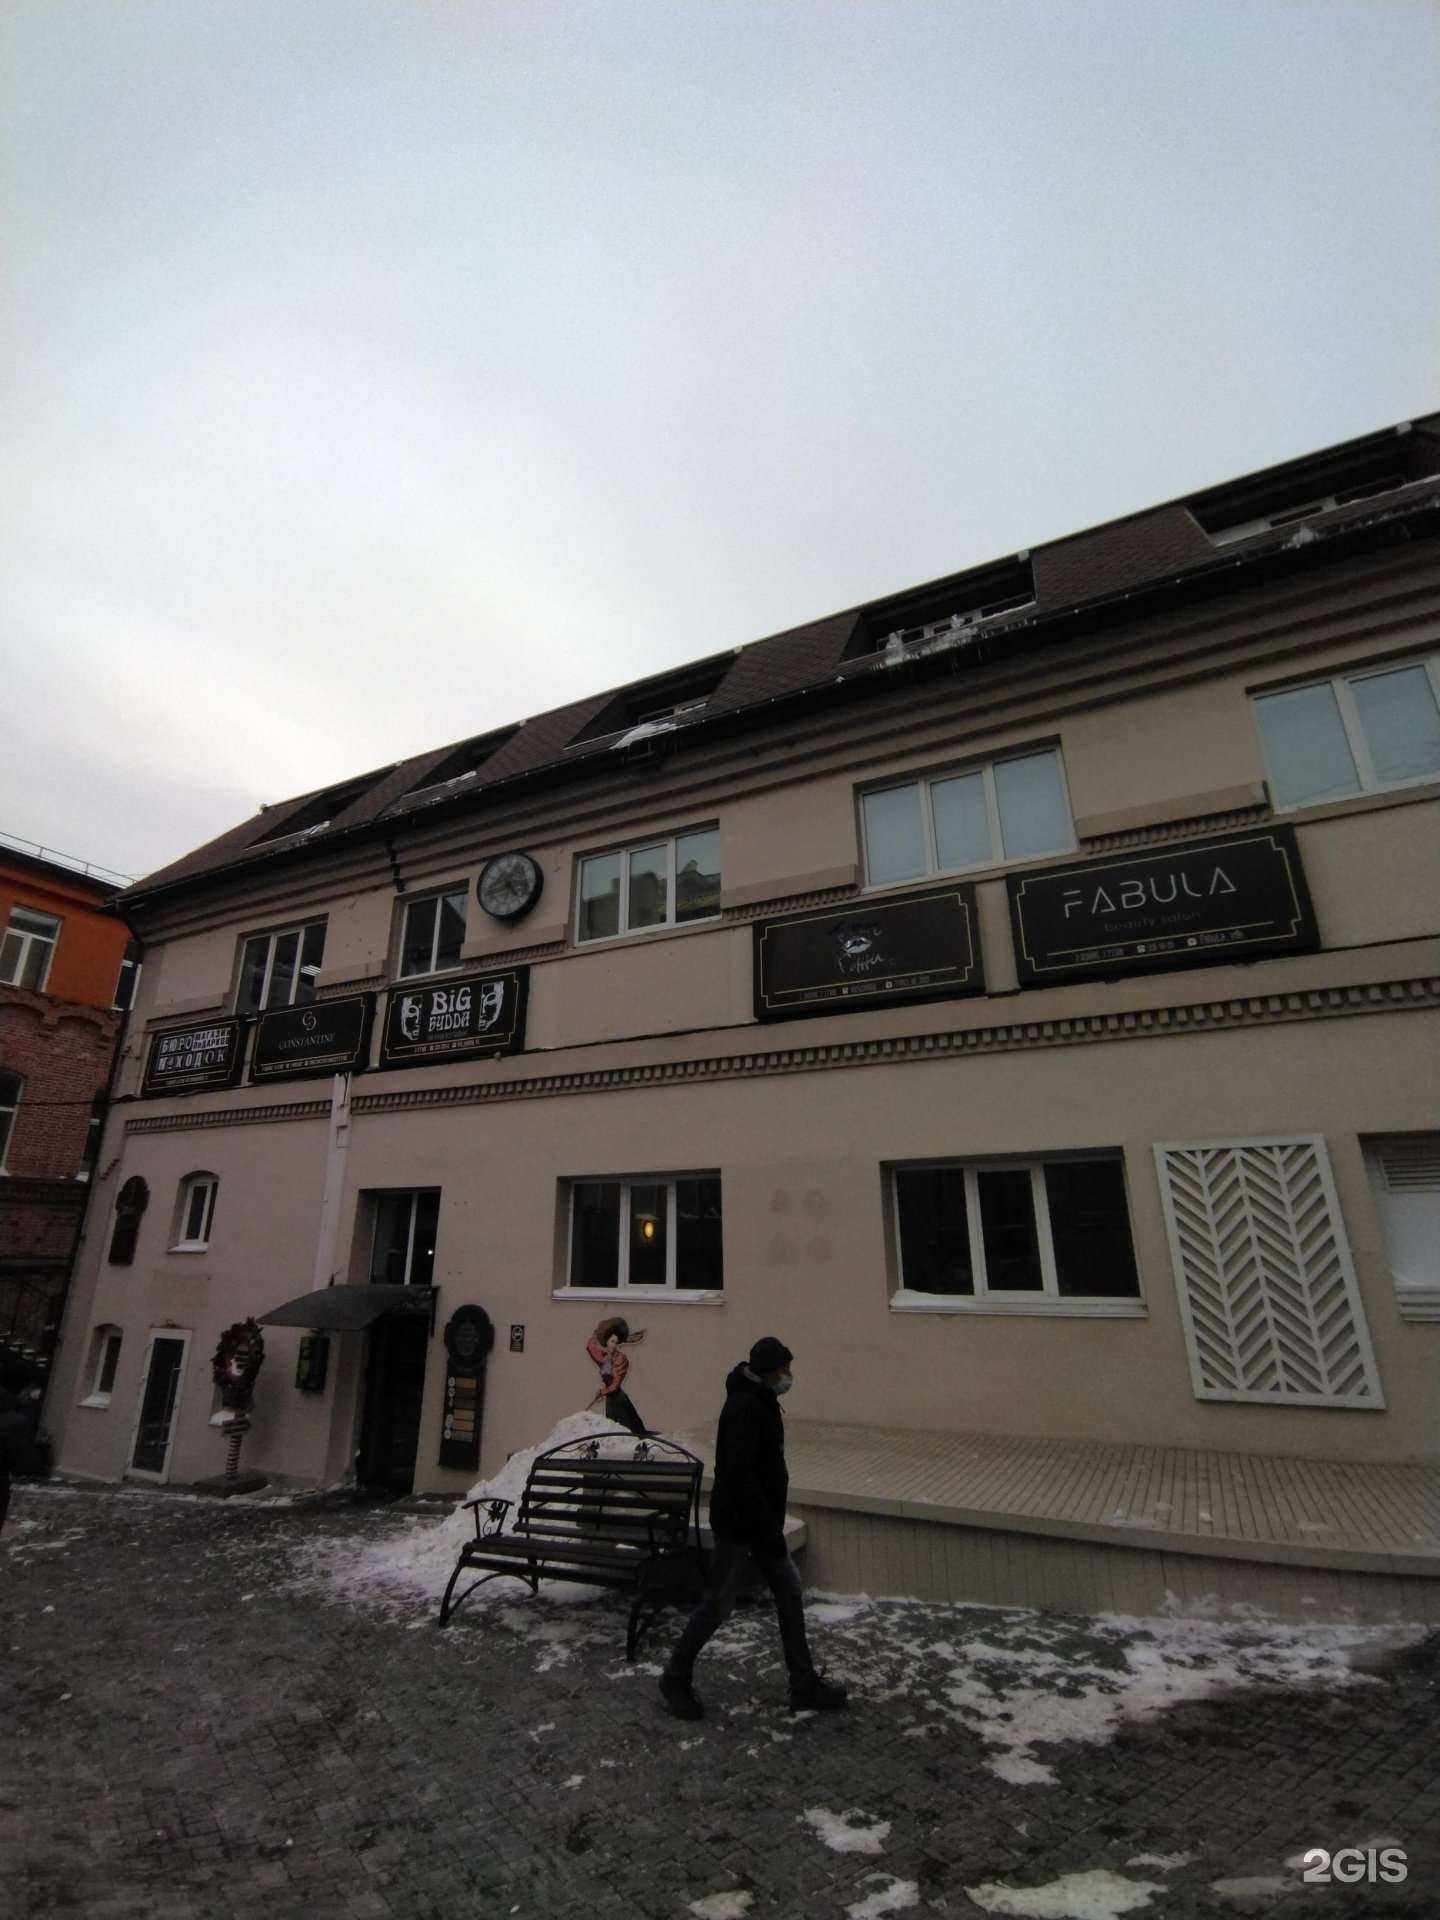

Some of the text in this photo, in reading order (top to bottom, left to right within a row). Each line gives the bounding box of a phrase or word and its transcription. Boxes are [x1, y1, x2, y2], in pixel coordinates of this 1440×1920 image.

[1062, 866, 1238, 919] FABULA
[160, 1035, 192, 1055] БЮРО
[278, 1032, 336, 1050] CONSTANTINE
